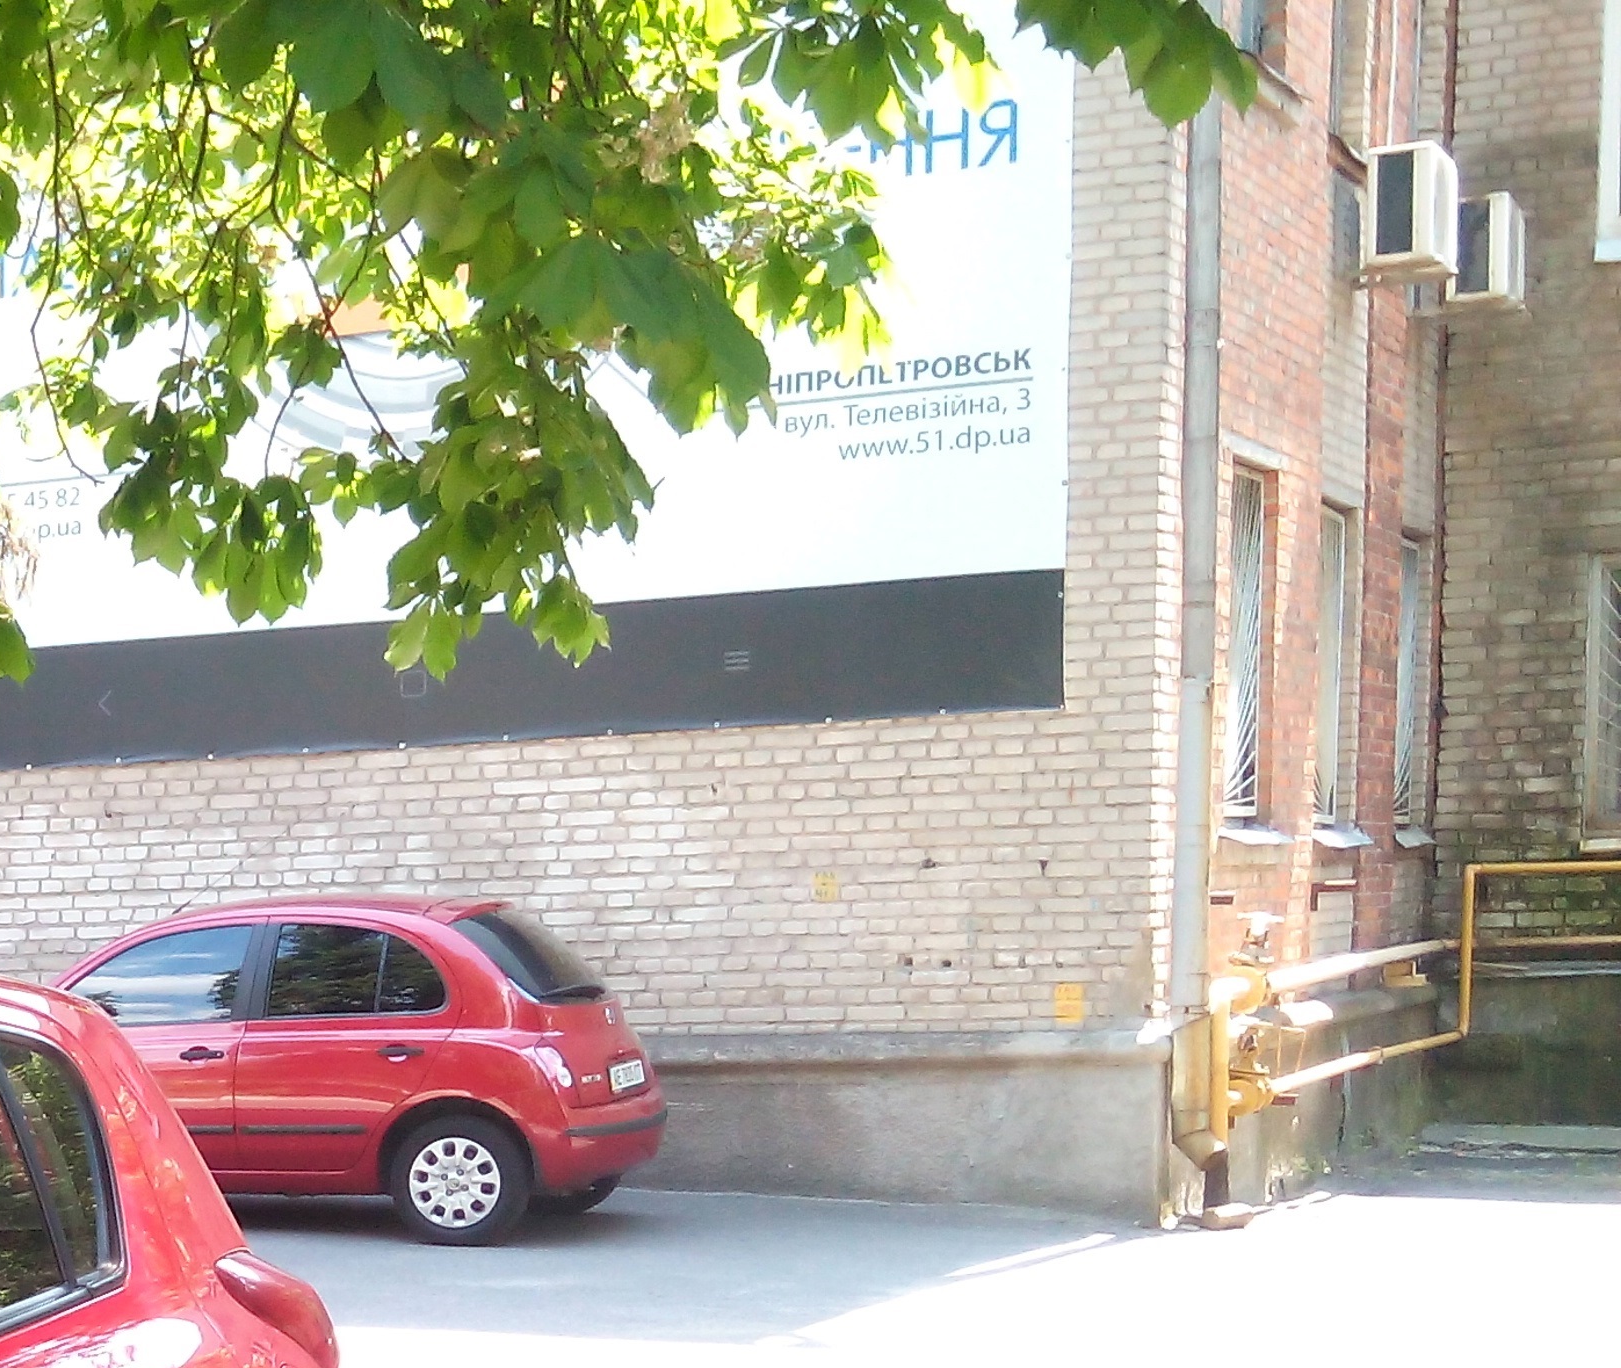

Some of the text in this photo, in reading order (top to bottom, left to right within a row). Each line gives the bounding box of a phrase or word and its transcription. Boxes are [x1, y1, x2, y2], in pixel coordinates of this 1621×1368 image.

[785, 387, 1032, 438] вул. Телевізійна, 3
[838, 424, 1031, 461] www.51.dp.ua
[56, 486, 81, 508] 82
[36, 519, 82, 544] p.ua
